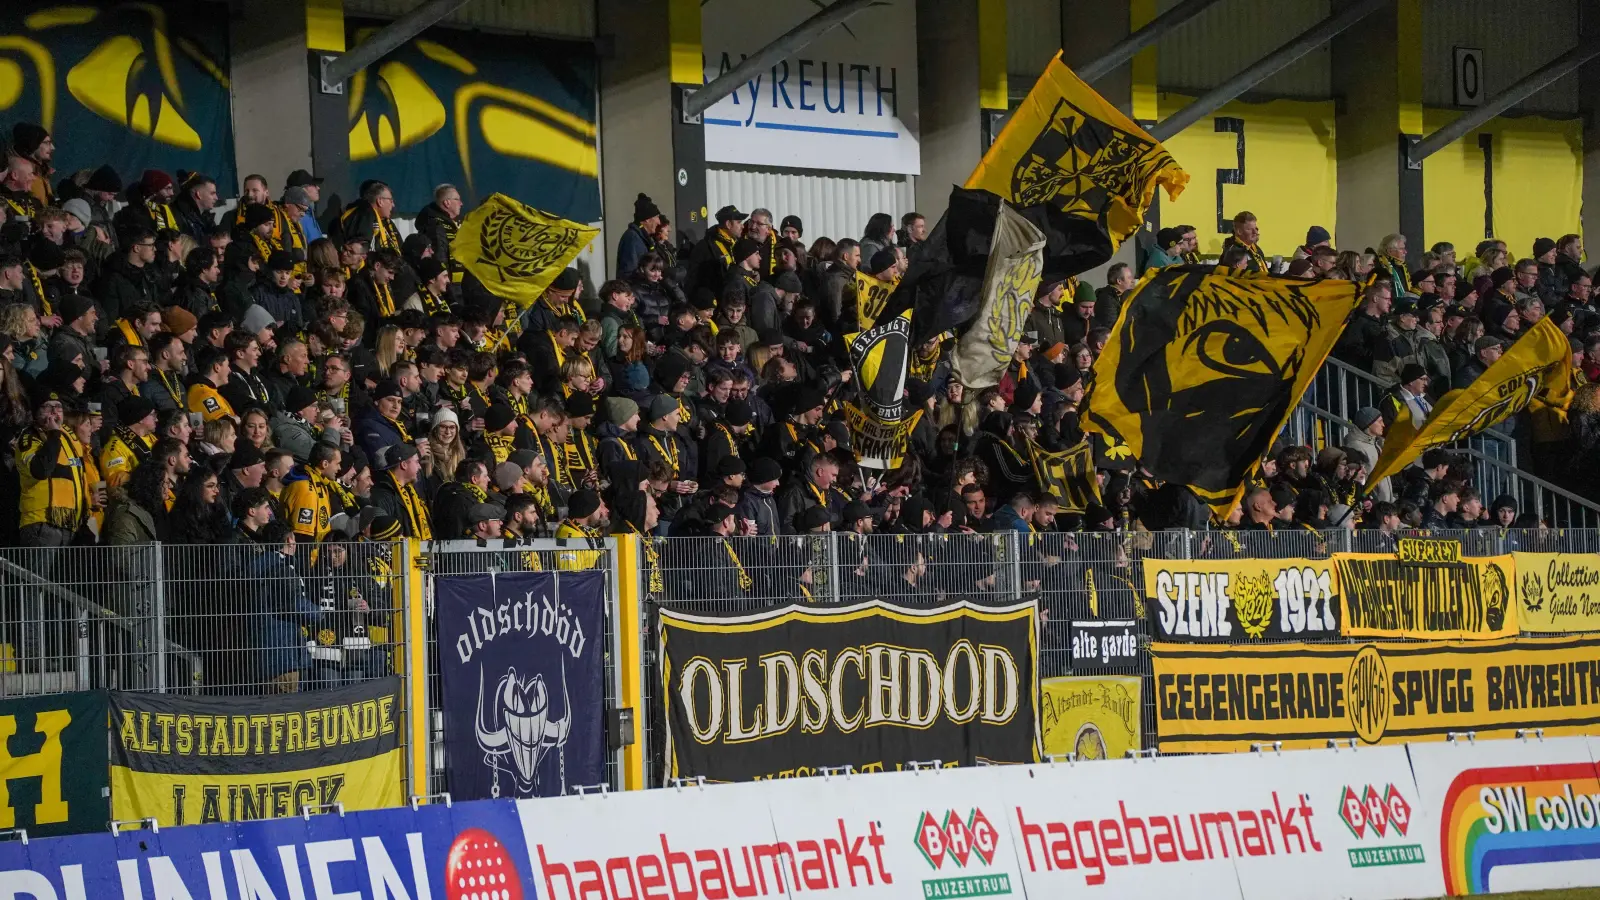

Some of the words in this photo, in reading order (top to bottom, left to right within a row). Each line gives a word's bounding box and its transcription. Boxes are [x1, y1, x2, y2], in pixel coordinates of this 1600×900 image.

[1214, 116, 1245, 234] 2
[855, 319, 910, 352] GEGENGE
[1547, 559, 1599, 593] Collettivo
[1156, 569, 1232, 637] SZENE
[1274, 566, 1336, 633] 1921
[1549, 593, 1578, 624] Giallo
[1073, 630, 1098, 659] alte
[1102, 628, 1137, 664] garde
[678, 638, 1020, 745] OLDSCHDOD
[1158, 672, 1345, 721] GEGENGERADE
[1392, 668, 1475, 717] SPVGG
[120, 694, 395, 756] ALTSTADTFREUNDE
[1347, 795, 1408, 827] BHG
[1480, 785, 1530, 835] SW
[536, 818, 893, 900] hagebaumarkt
[925, 820, 994, 856] BHG
[1016, 790, 1323, 885] hagebaumarkt
[1350, 846, 1423, 865] BAUZENTRUM
[924, 876, 1010, 898] BAUZENTRUM
